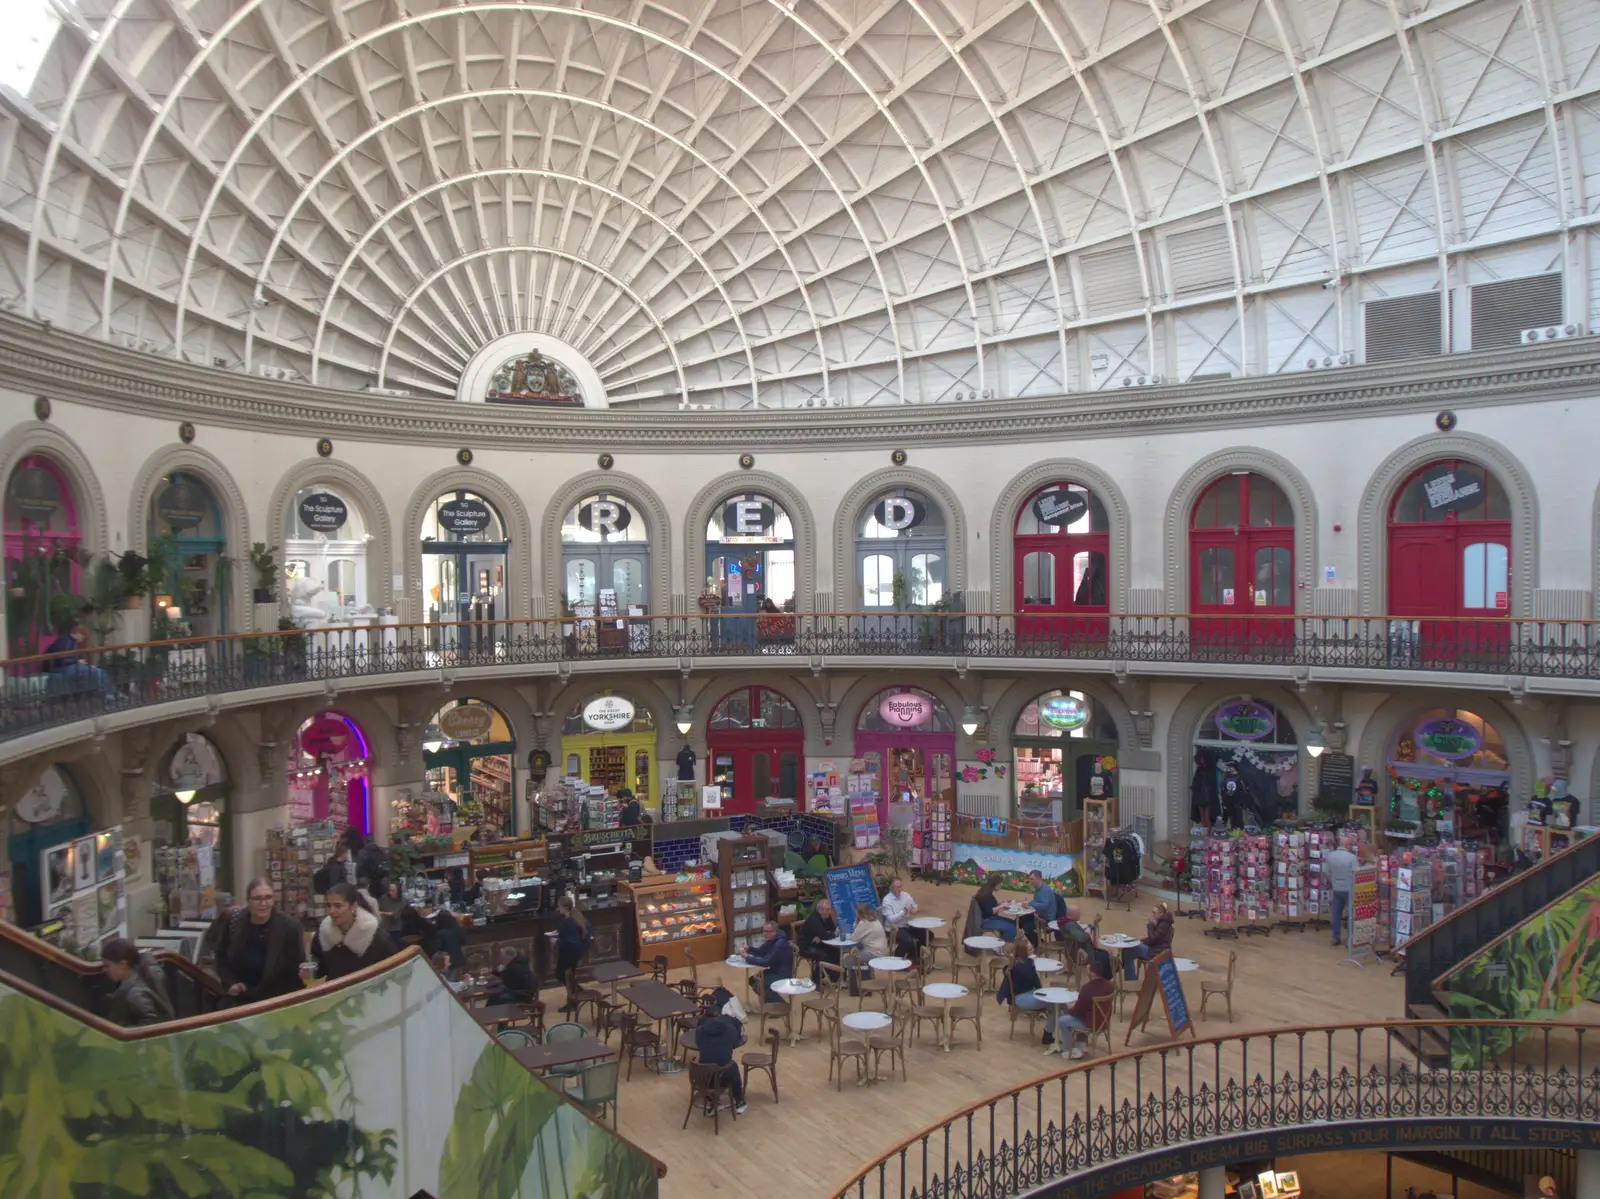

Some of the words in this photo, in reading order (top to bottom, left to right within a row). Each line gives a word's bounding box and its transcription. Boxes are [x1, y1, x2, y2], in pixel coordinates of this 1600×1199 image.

[1440, 415, 1450, 425] 4
[462, 451, 469, 461] 8
[743, 456, 750, 465] 6
[896, 452, 903, 461] 5
[603, 457, 610, 466] 7
[303, 504, 314, 512] The
[315, 504, 344, 514] Sculpture
[455, 509, 486, 518] Sculpture
[885, 498, 914, 530] D
[313, 514, 337, 524] Gallery
[454, 518, 478, 526] Gallery
[591, 502, 620, 533] R
[737, 502, 762, 532] E
[889, 706, 923, 715] Planning
[588, 712, 630, 721] YORKSHIRE
[583, 828, 635, 844] BRUSCHETTA
[1084, 1175, 1110, 1196] THE
[1190, 1144, 1239, 1166] DREAM
[1277, 1132, 1344, 1151] SURPASS
[1350, 1127, 1389, 1144] YOUR
[1470, 1126, 1485, 1140] IT
[1489, 1126, 1522, 1141] ALL
[1528, 1127, 1582, 1143] STOPS
